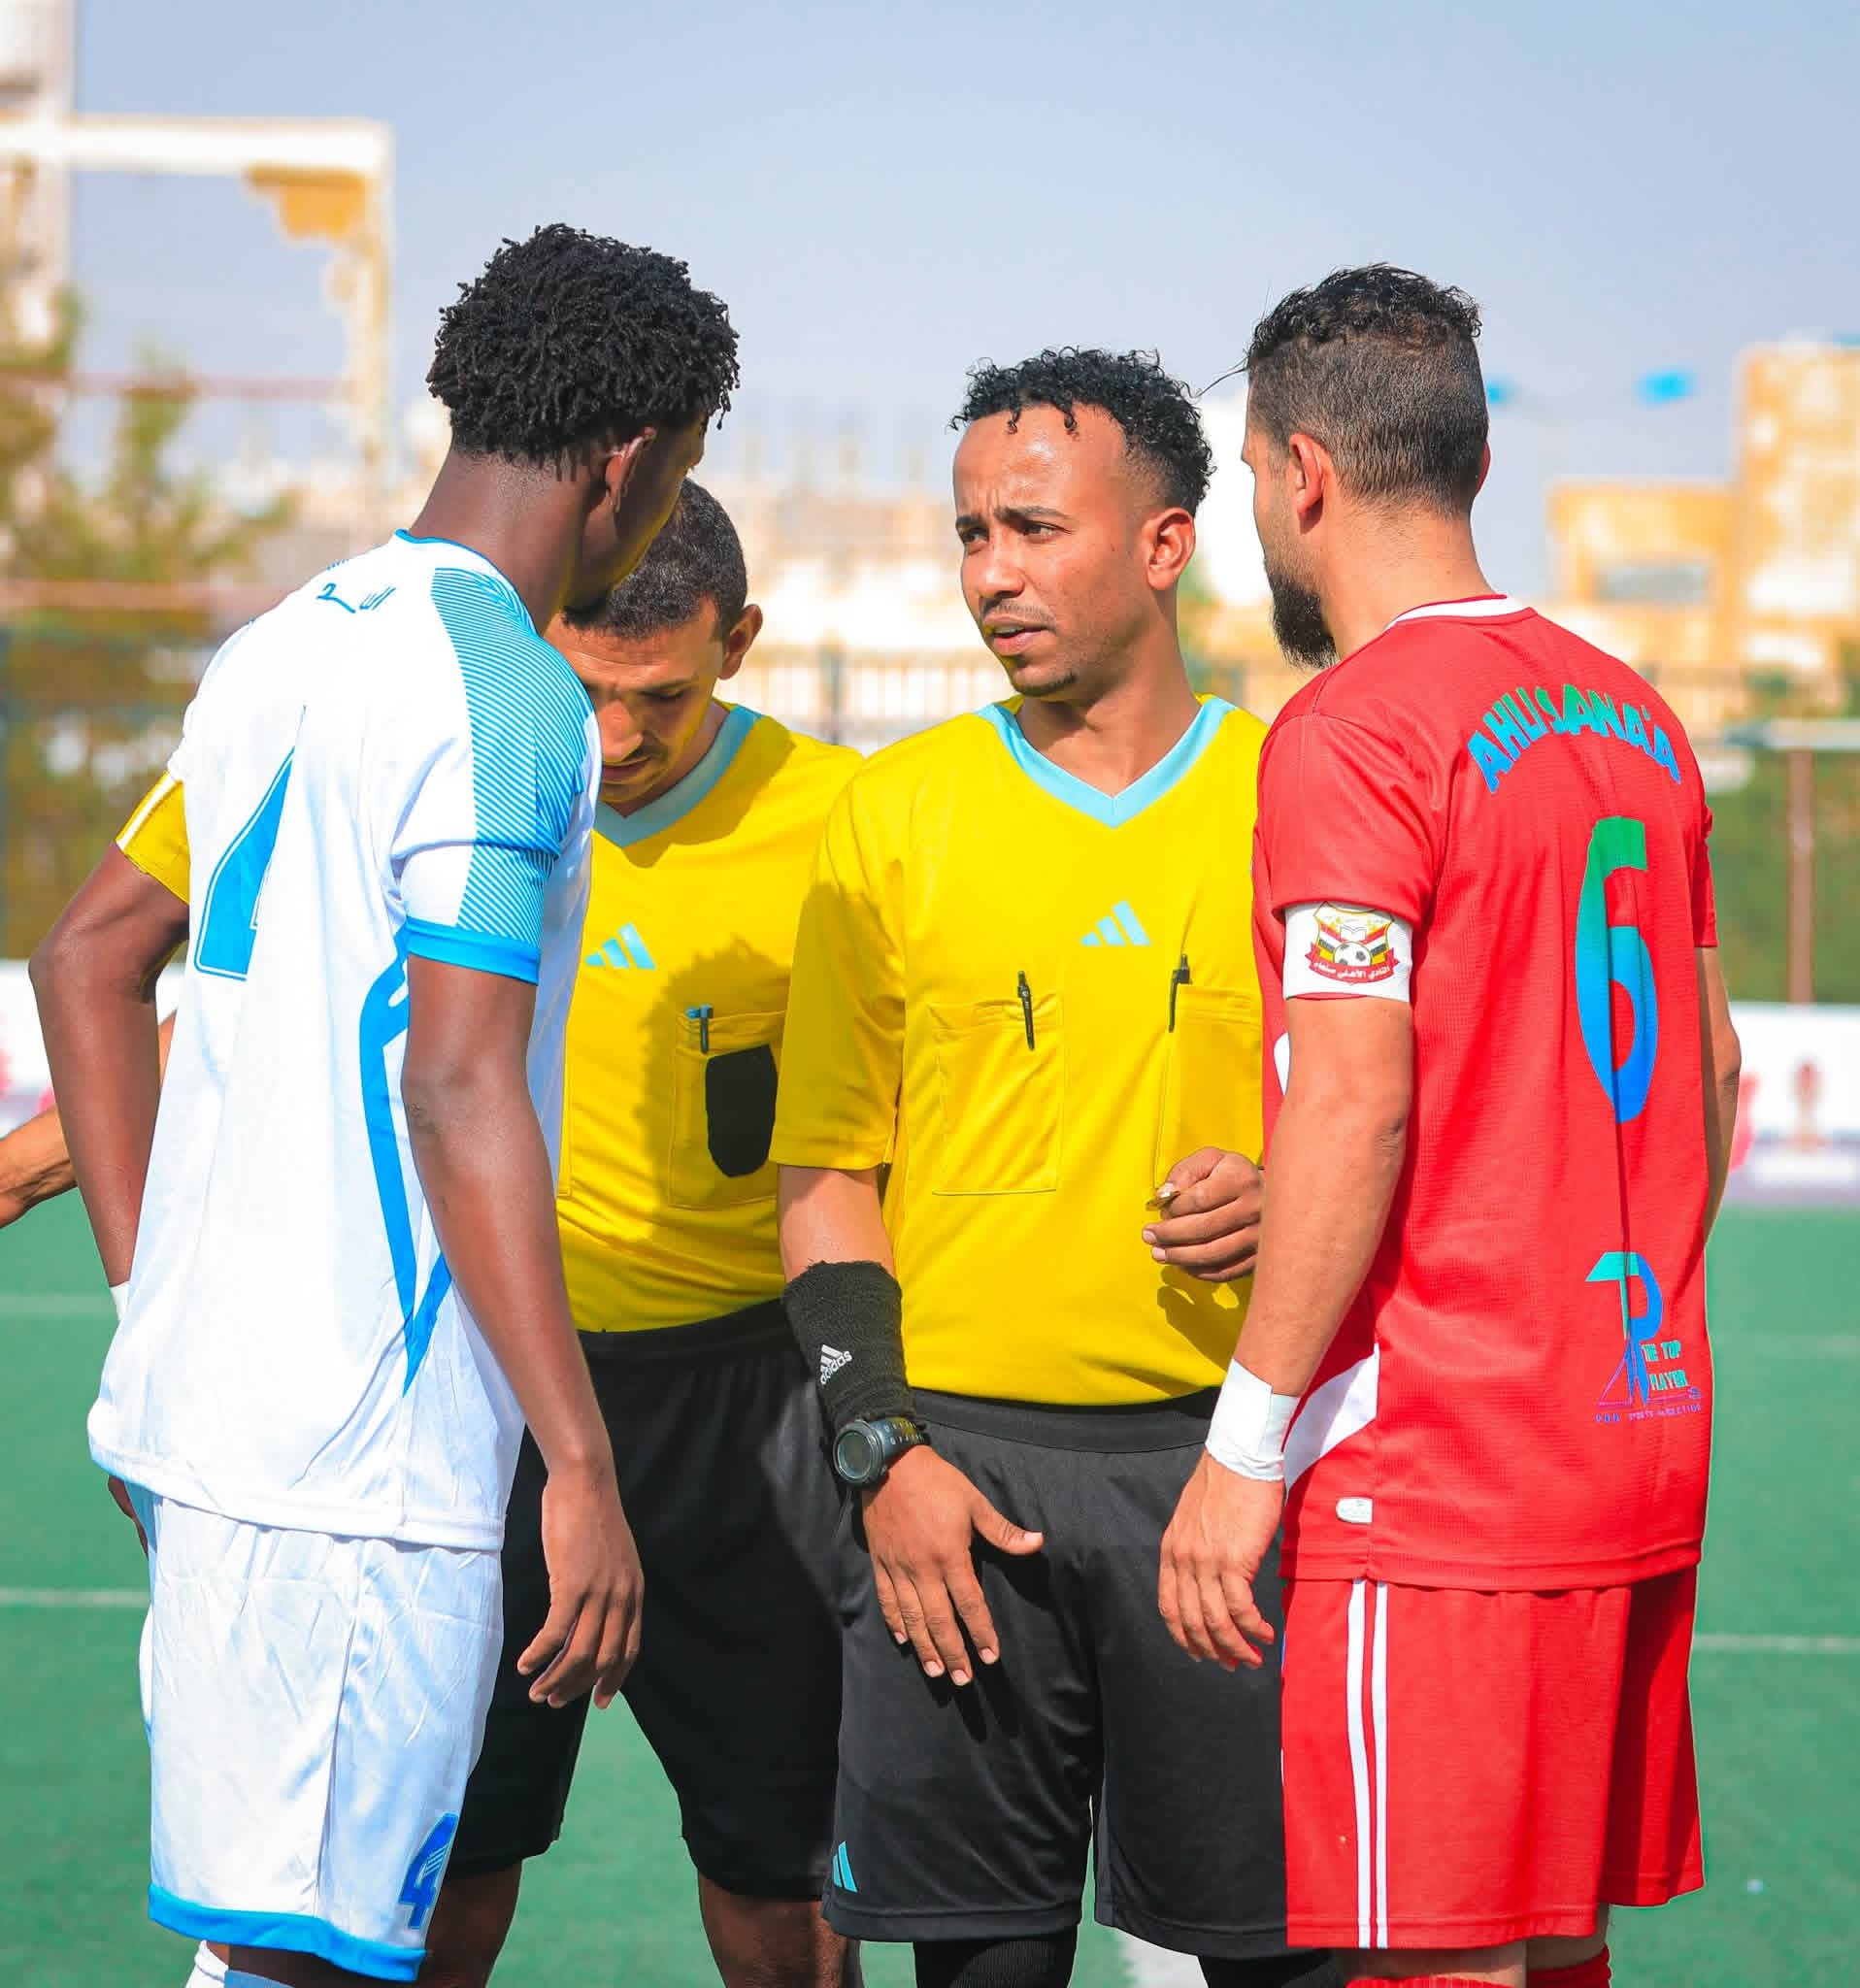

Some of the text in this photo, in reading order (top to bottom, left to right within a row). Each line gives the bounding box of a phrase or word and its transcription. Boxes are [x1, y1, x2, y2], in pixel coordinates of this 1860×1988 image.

[1575, 815, 1658, 1124] 6
[820, 1350, 852, 1385] adidas
[397, 1812, 459, 1930] 4
